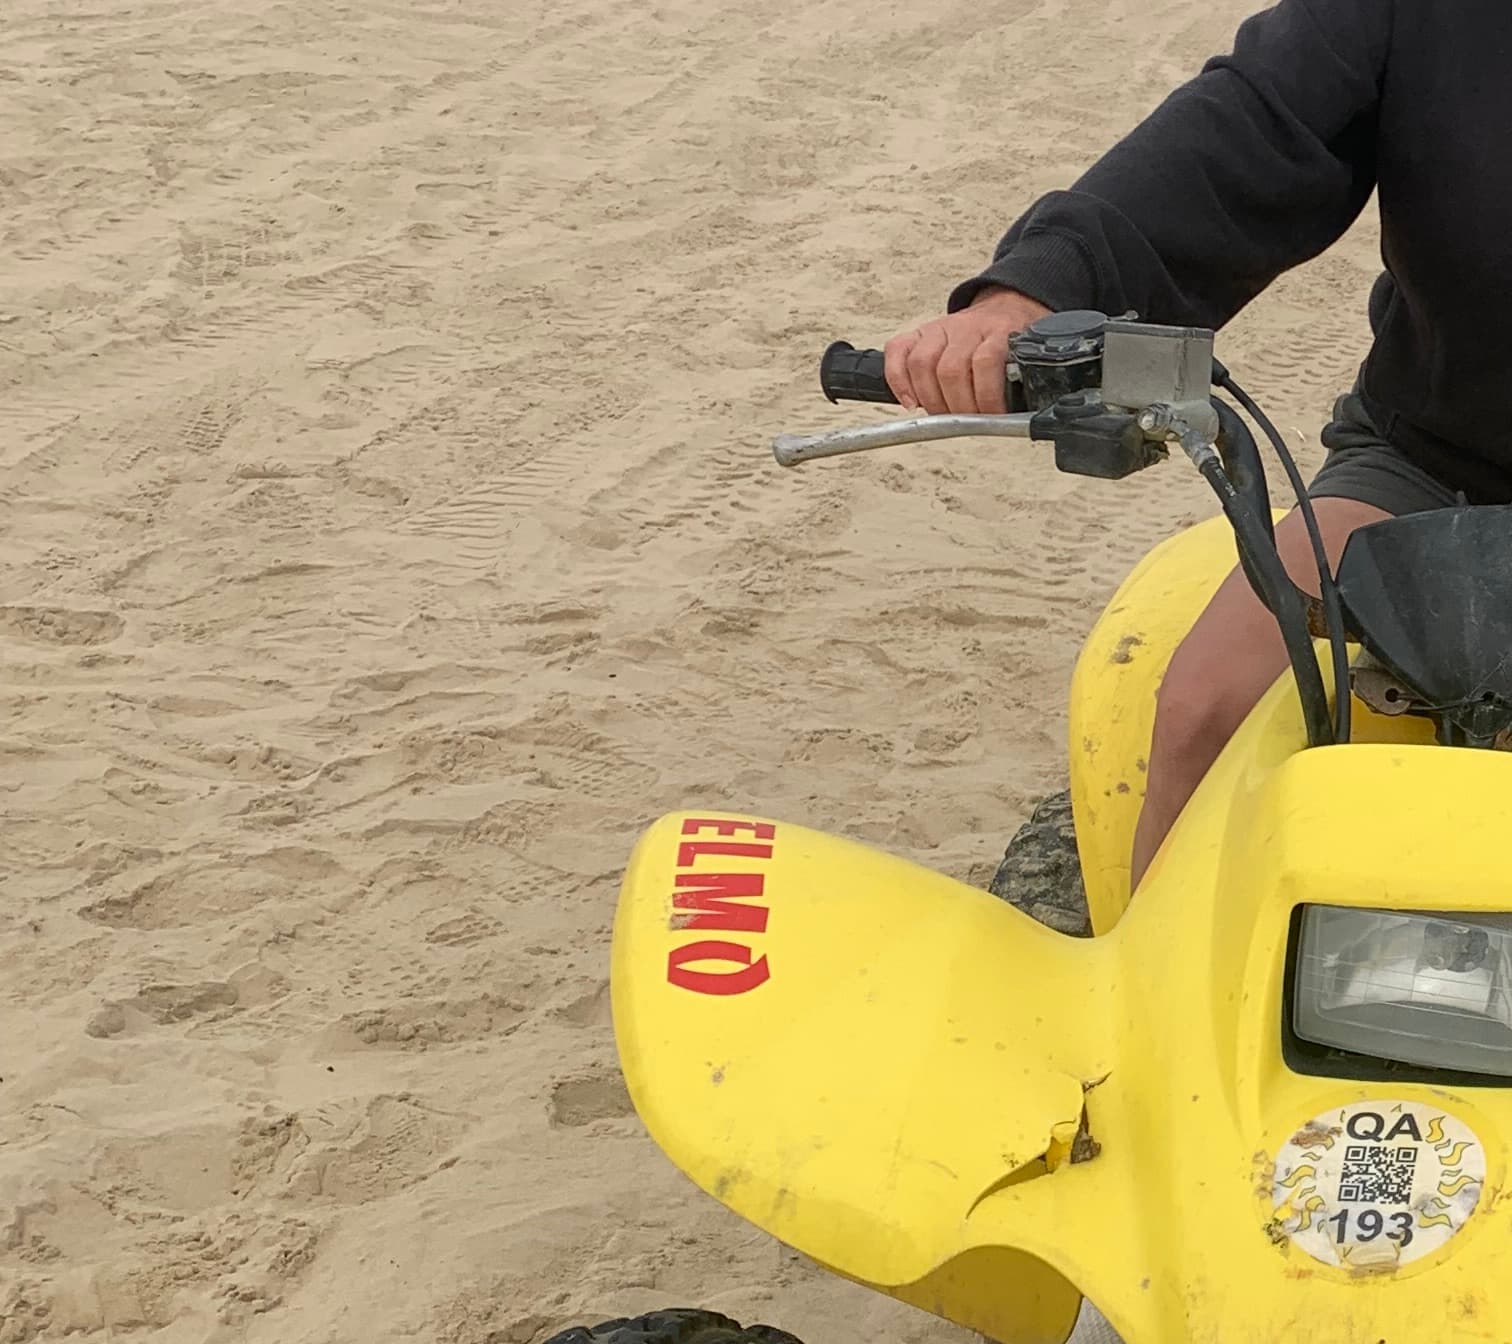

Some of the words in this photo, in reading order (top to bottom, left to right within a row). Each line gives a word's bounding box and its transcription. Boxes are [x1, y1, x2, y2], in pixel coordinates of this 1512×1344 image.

[667, 818, 776, 996] ELMO
[1346, 1112, 1423, 1143] QA
[1328, 1208, 1415, 1248] 193
